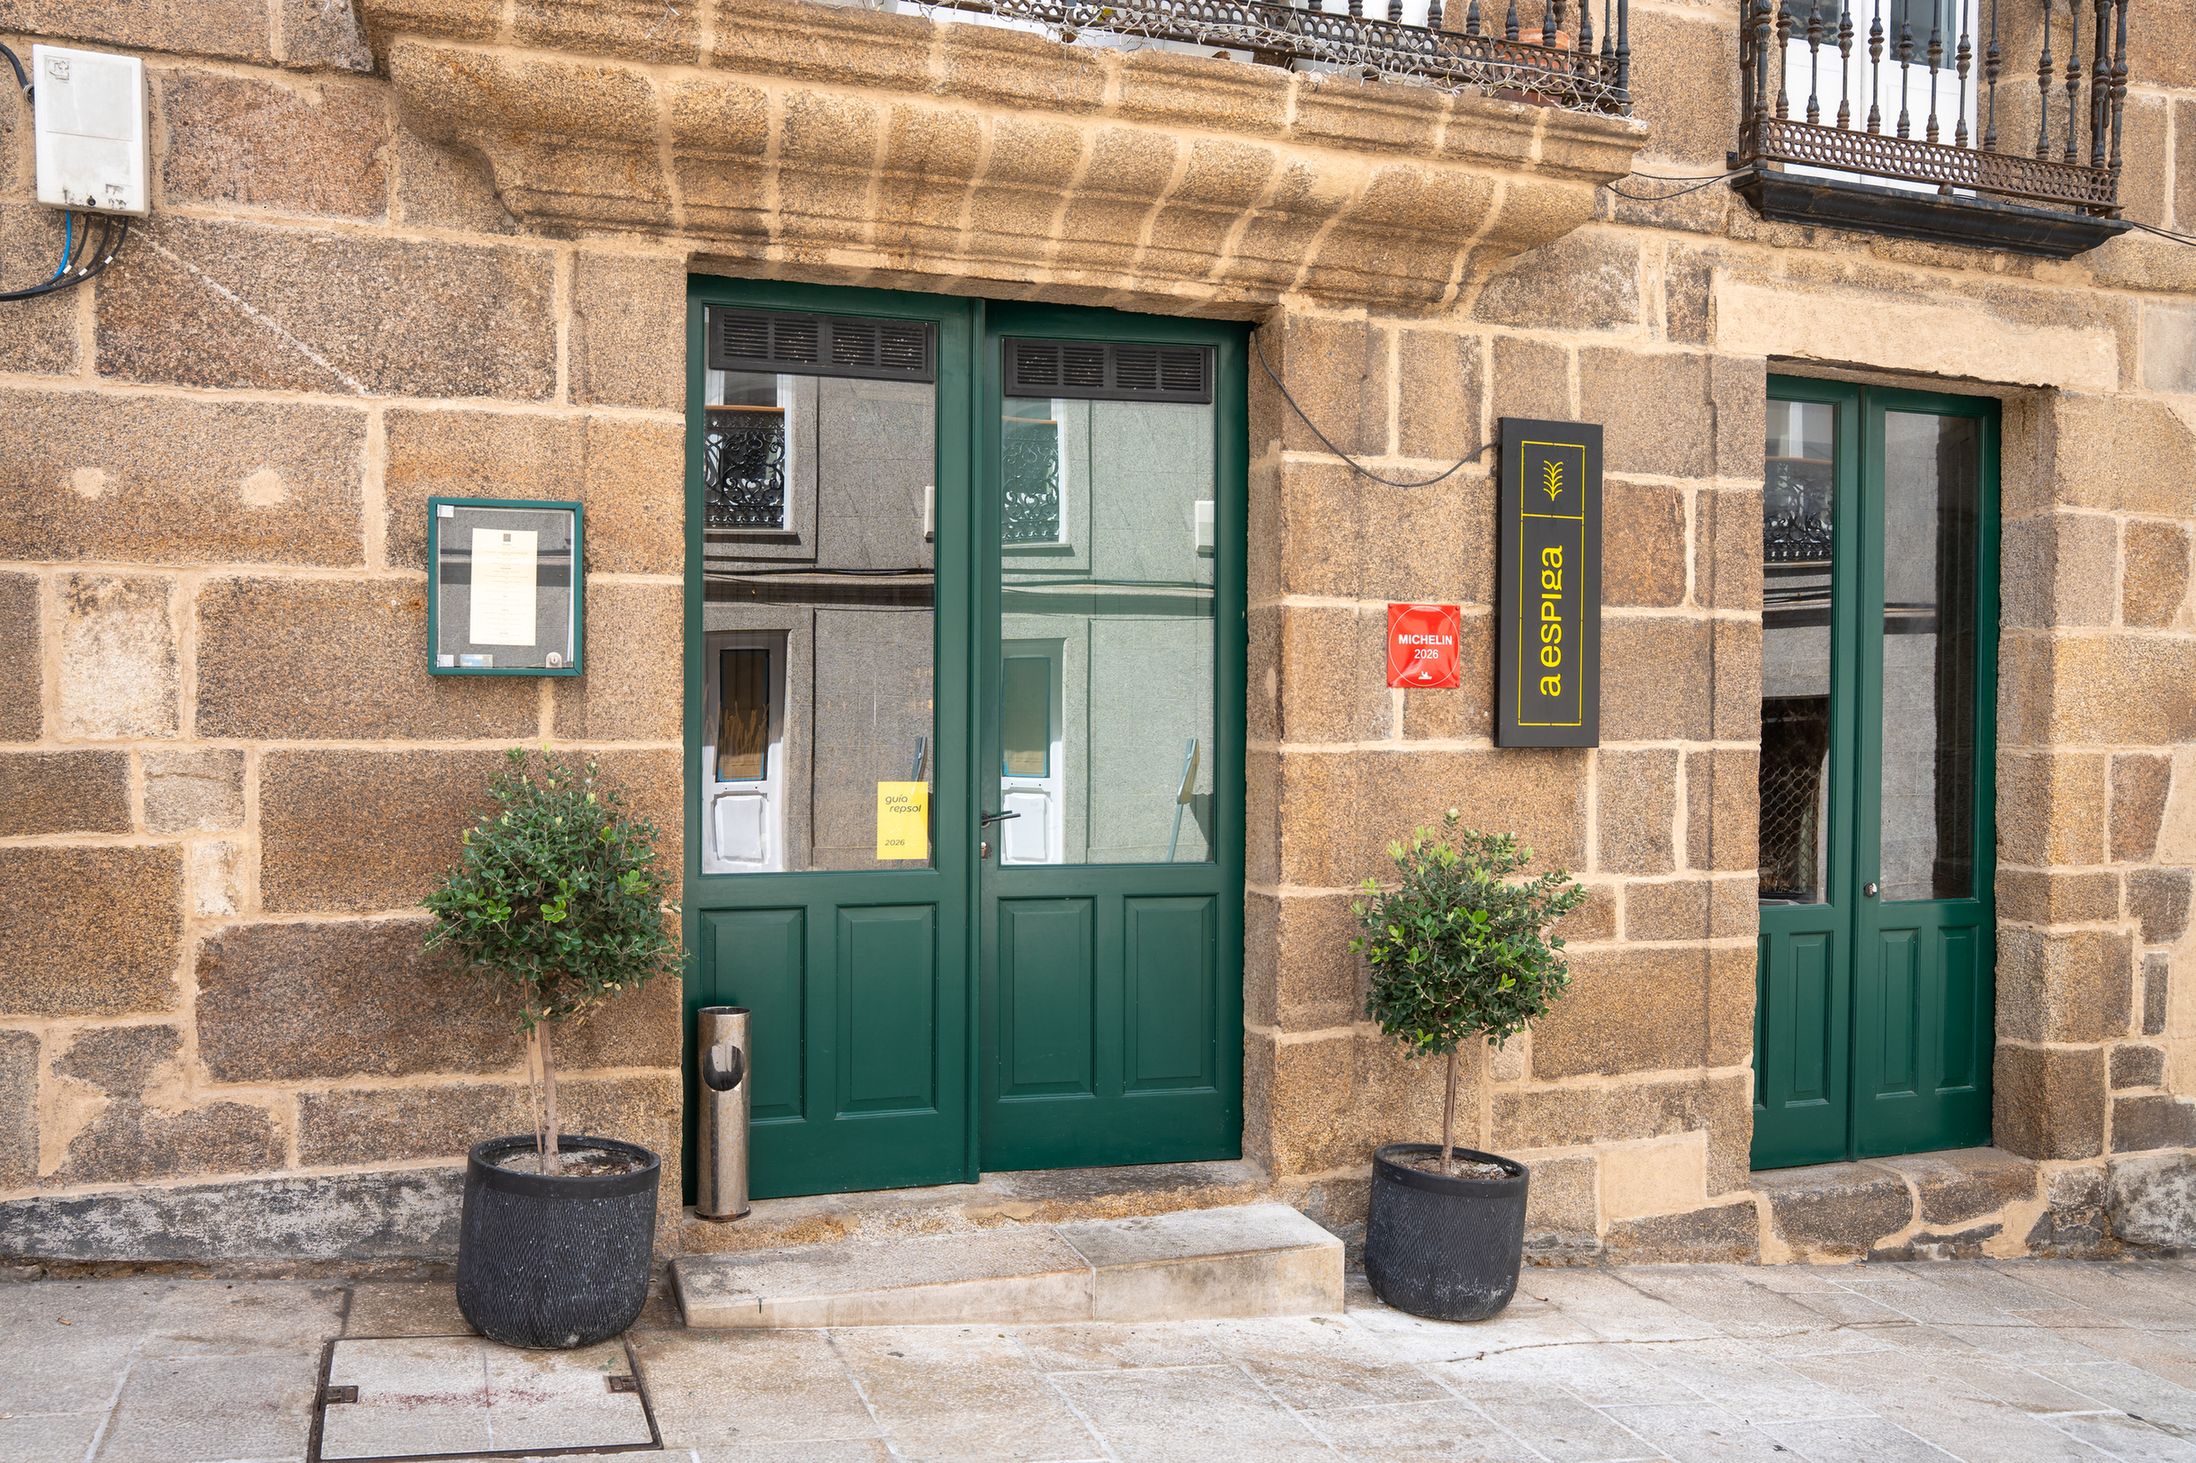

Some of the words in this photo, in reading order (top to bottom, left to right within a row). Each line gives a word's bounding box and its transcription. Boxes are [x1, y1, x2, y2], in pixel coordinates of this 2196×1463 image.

[1398, 633, 1452, 646] MICHELIN
[1414, 648, 1439, 659] 2026
[1539, 673, 1562, 697] a
[889, 804, 922, 814] repsol
